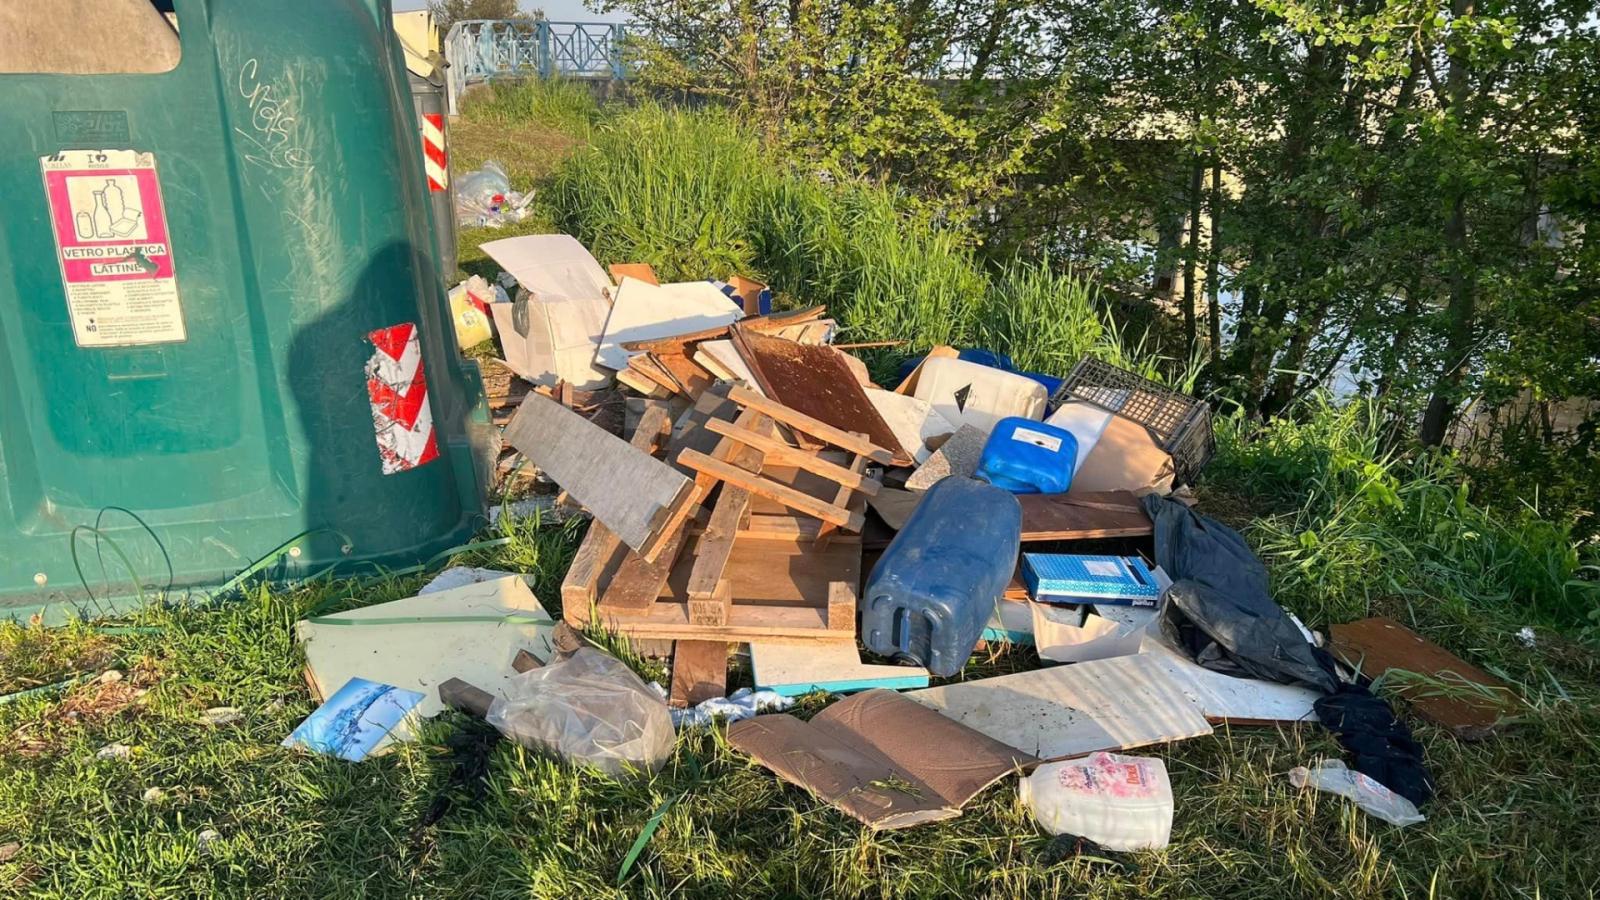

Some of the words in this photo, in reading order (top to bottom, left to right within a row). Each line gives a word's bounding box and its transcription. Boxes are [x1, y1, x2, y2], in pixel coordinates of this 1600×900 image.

[64, 248, 104, 258] VETRO
[107, 245, 166, 256] PLASICA
[93, 263, 142, 274] LATTINE
[86, 323, 97, 332] NO
